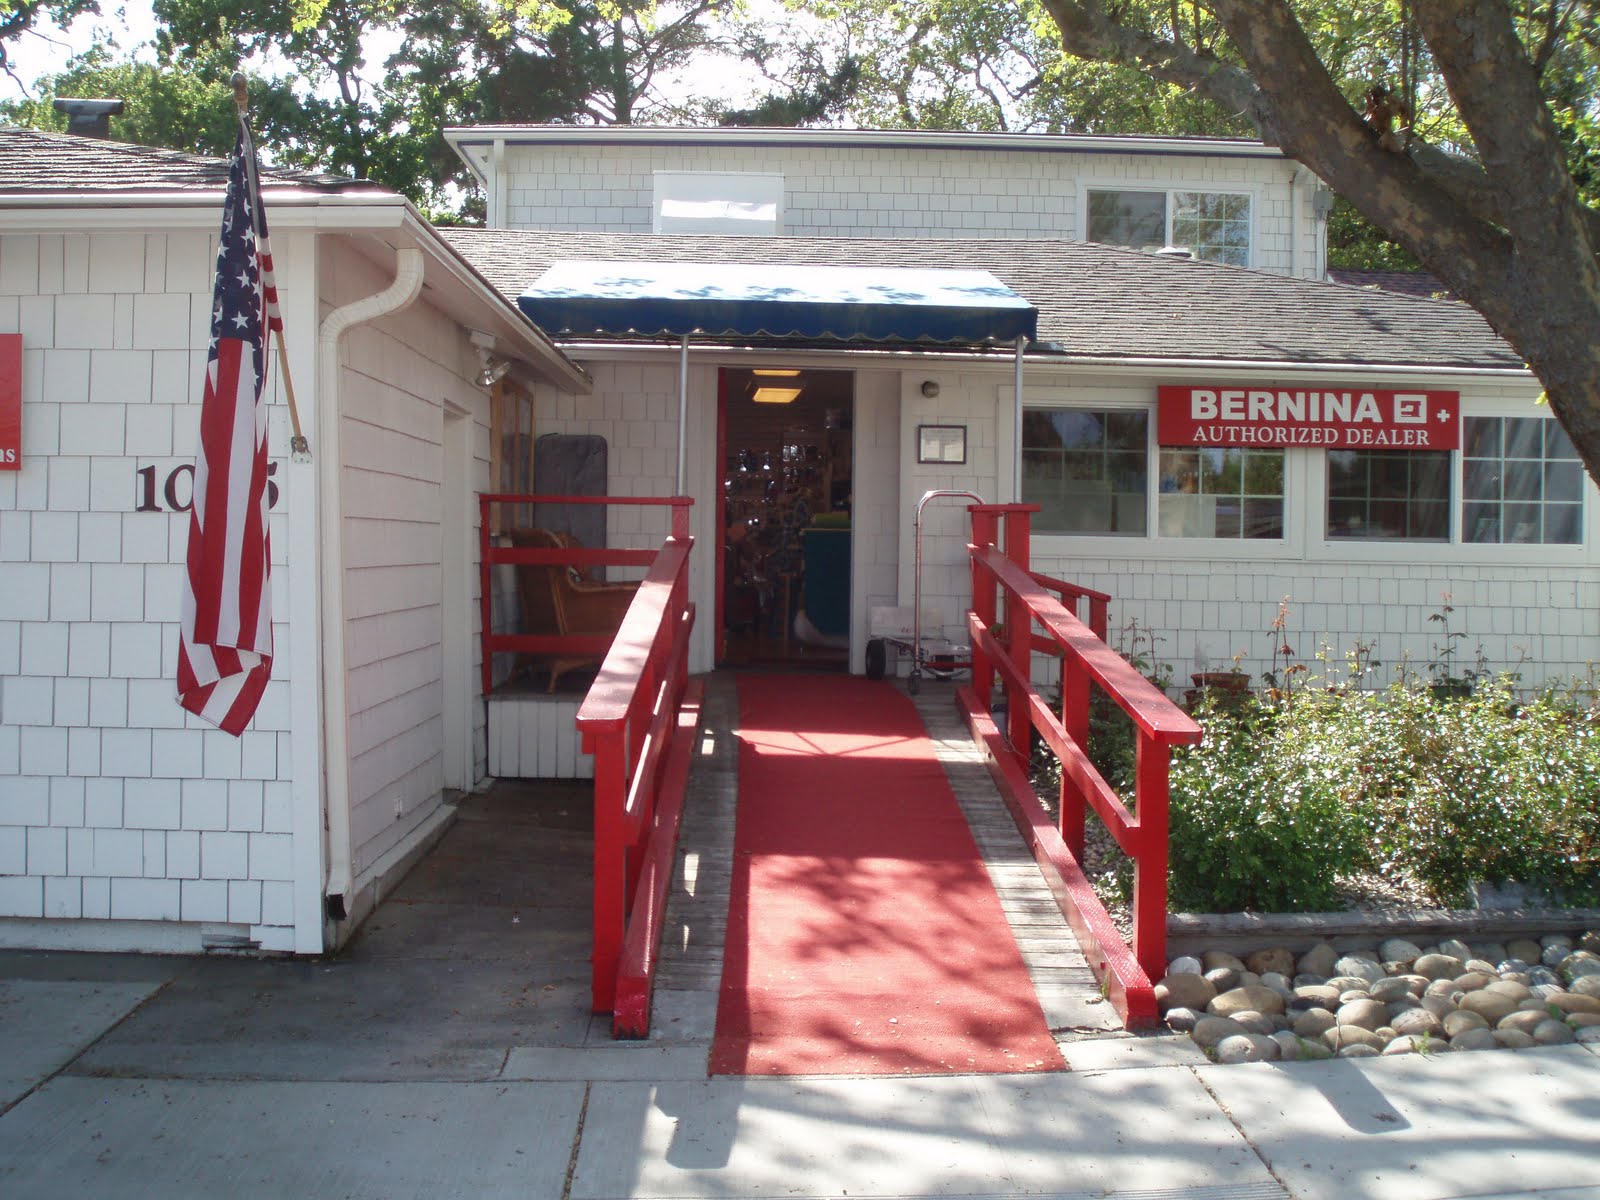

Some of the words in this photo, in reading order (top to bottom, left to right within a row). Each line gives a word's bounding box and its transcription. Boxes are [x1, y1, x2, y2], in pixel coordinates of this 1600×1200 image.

[1191, 390, 1383, 423] BERNINA
[1193, 426, 1339, 444] AUTHORIZED
[1346, 428, 1430, 446] DEALER
